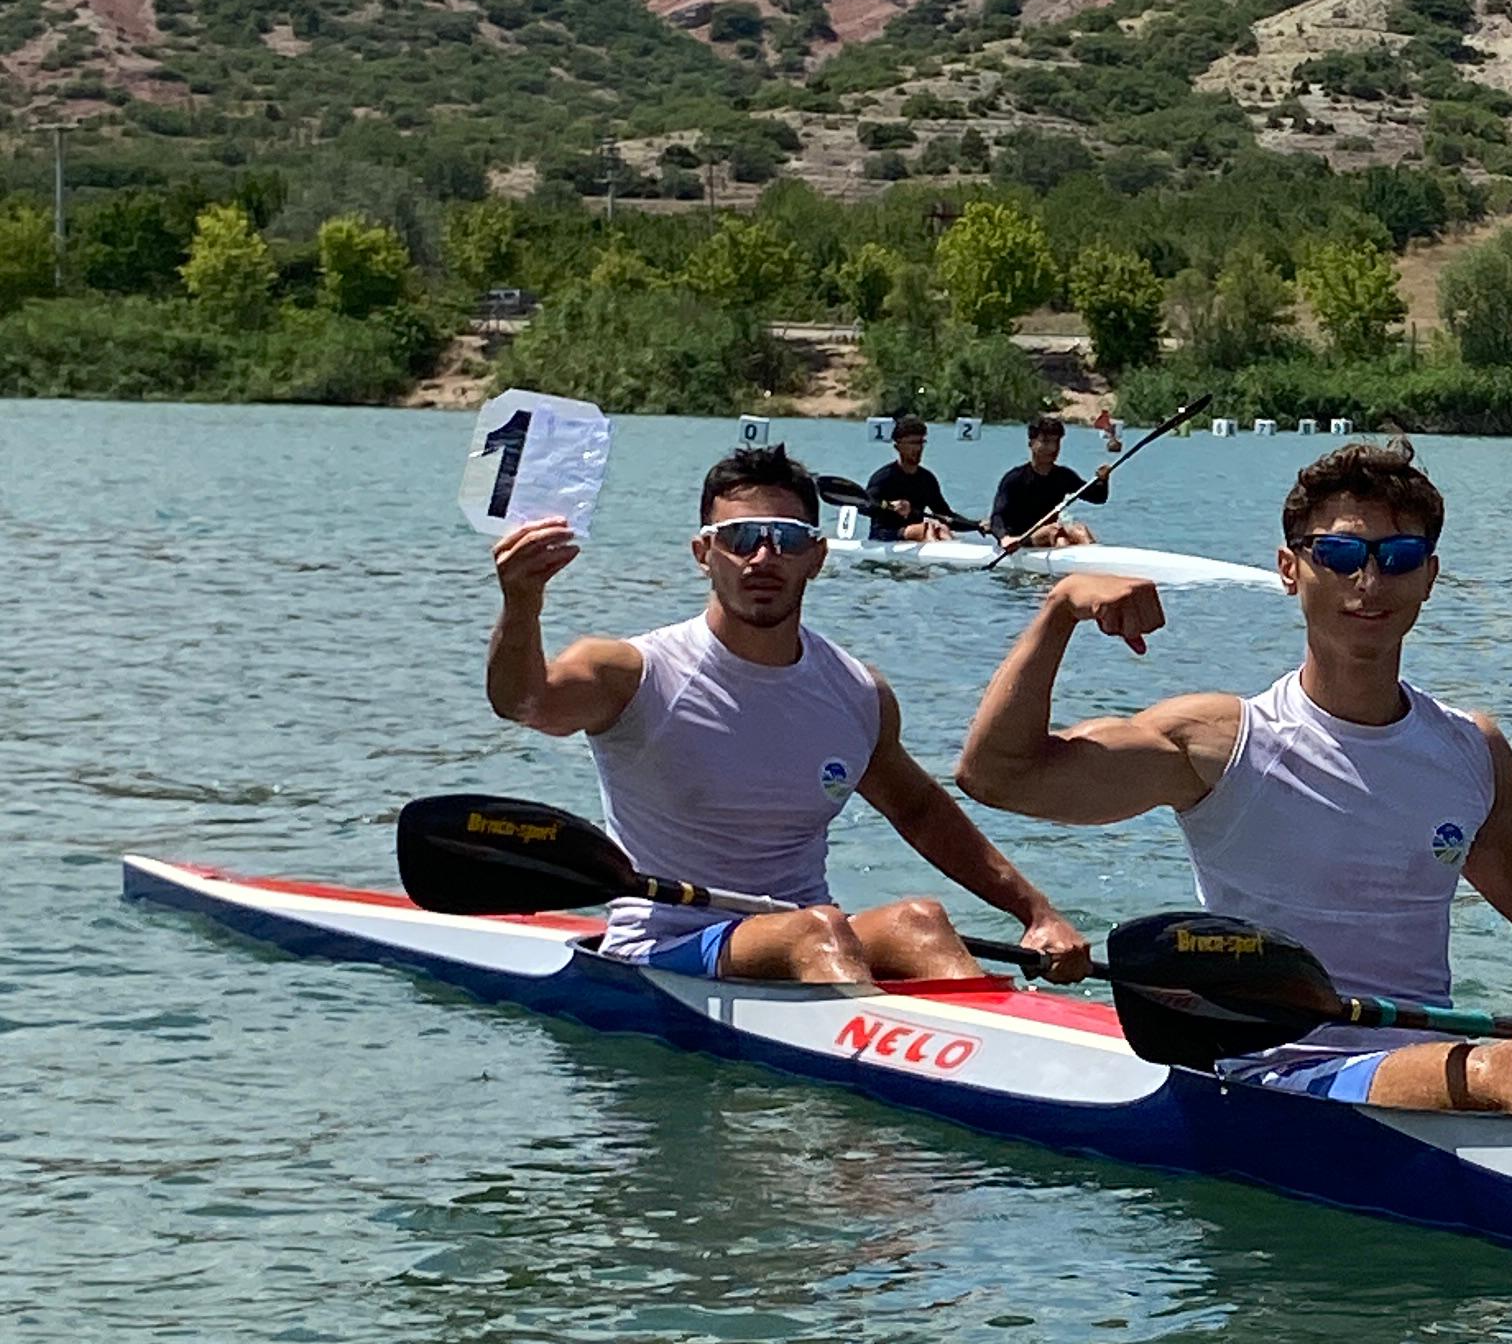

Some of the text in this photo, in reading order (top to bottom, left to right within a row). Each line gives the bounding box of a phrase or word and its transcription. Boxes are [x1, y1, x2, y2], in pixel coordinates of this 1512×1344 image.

[744, 424, 758, 441] 0
[874, 424, 885, 440] 1
[962, 423, 973, 439] 2
[481, 409, 532, 519] 1
[835, 1016, 975, 1069] NELO
